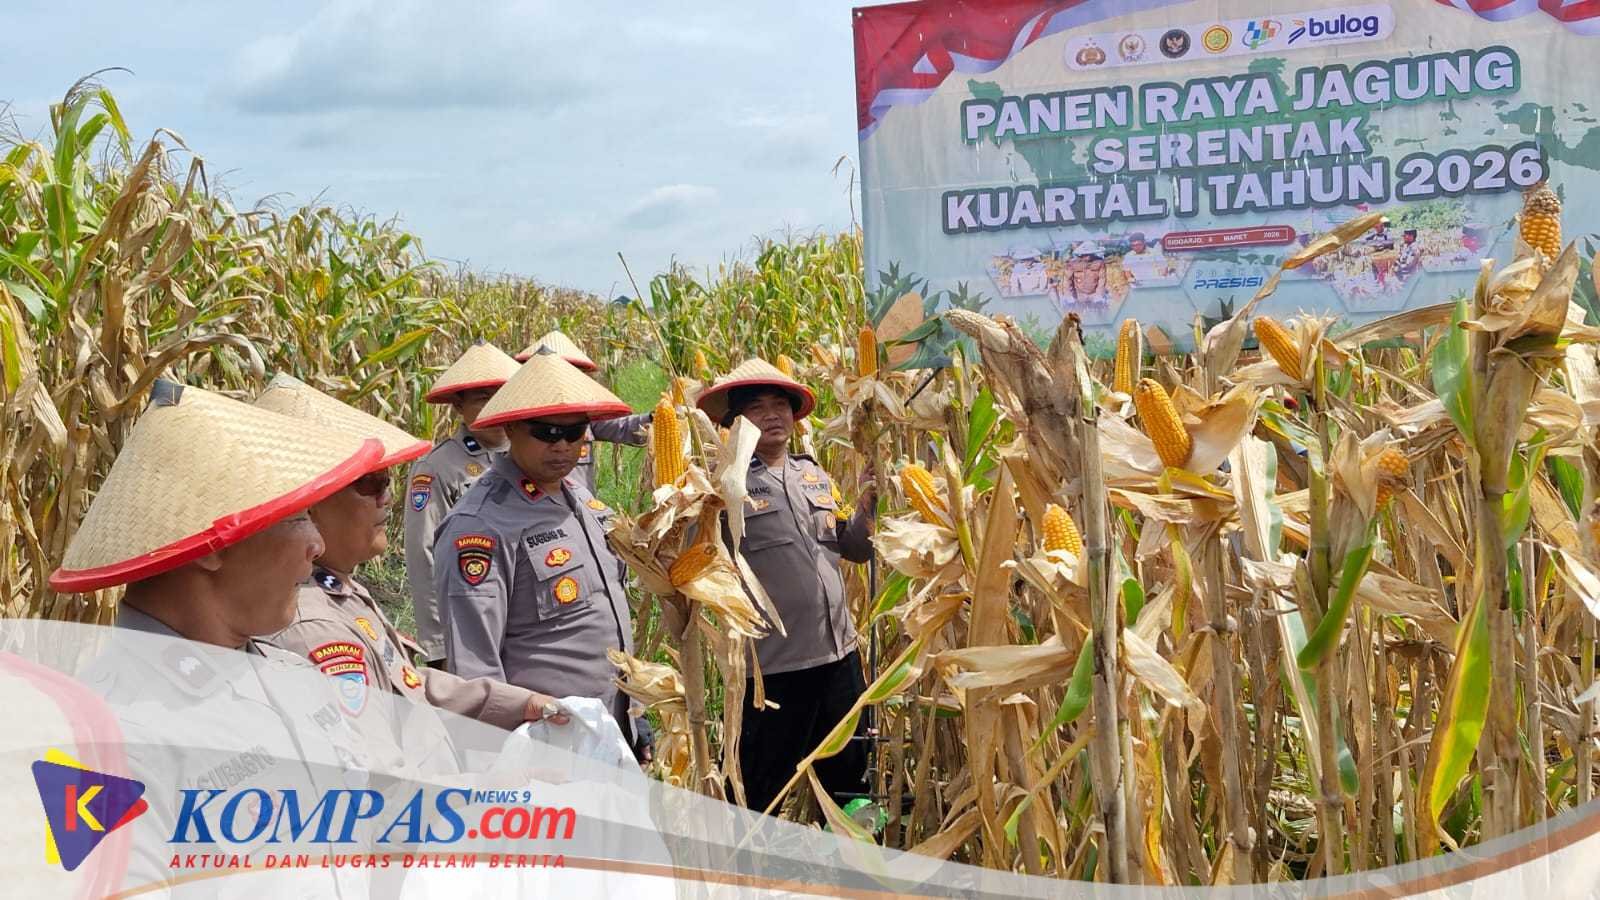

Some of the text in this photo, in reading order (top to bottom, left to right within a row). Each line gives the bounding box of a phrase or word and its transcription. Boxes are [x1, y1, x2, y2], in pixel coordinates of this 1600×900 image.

[1309, 14, 1379, 37] bulog
[966, 51, 1514, 140] PANEN RAYA JAGUNG
[1093, 116, 1366, 174] SERENTAK
[947, 148, 1543, 230] KUARTAL I TAHUN 2026
[1194, 276, 1263, 289] PRESISI
